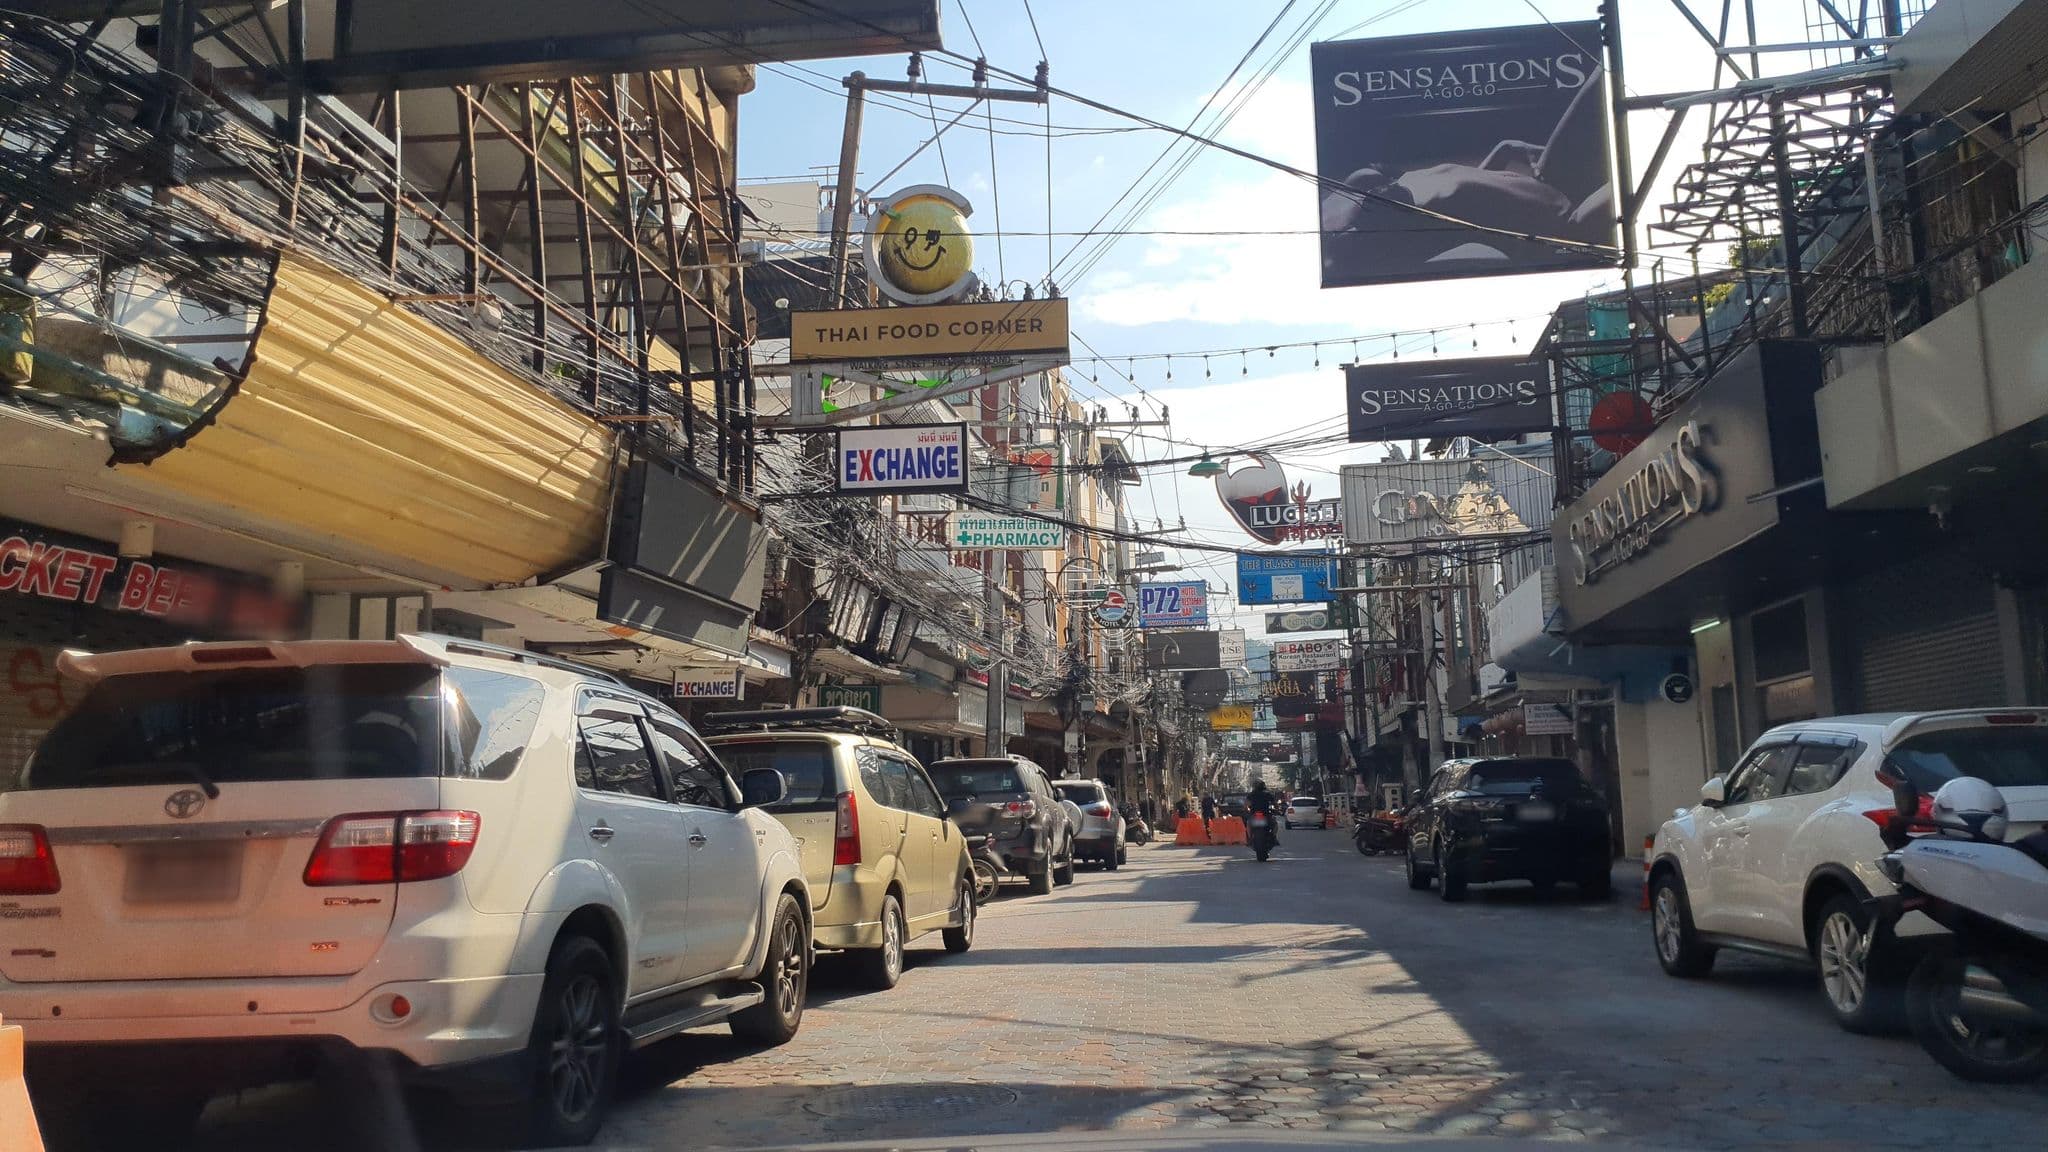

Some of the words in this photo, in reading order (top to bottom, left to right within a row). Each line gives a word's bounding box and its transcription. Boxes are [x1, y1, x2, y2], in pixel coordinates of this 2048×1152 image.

[1334, 53, 1586, 106] SENSATIONS
[1423, 84, 1496, 100] A-GO-GO
[816, 326, 868, 343] THAI
[878, 323, 940, 340] FOOD
[949, 318, 1043, 336] CORNER
[1360, 380, 1537, 416] SENSATIONS
[1423, 401, 1475, 412] A-GO-GO
[845, 445, 960, 483] EXCHANGE
[1569, 420, 1704, 587] SENSATIONS
[973, 532, 1061, 546] PHARMACY
[1141, 586, 1181, 614] P72
[1289, 643, 1323, 654] BABO
[676, 680, 735, 697] EXCHANGE
